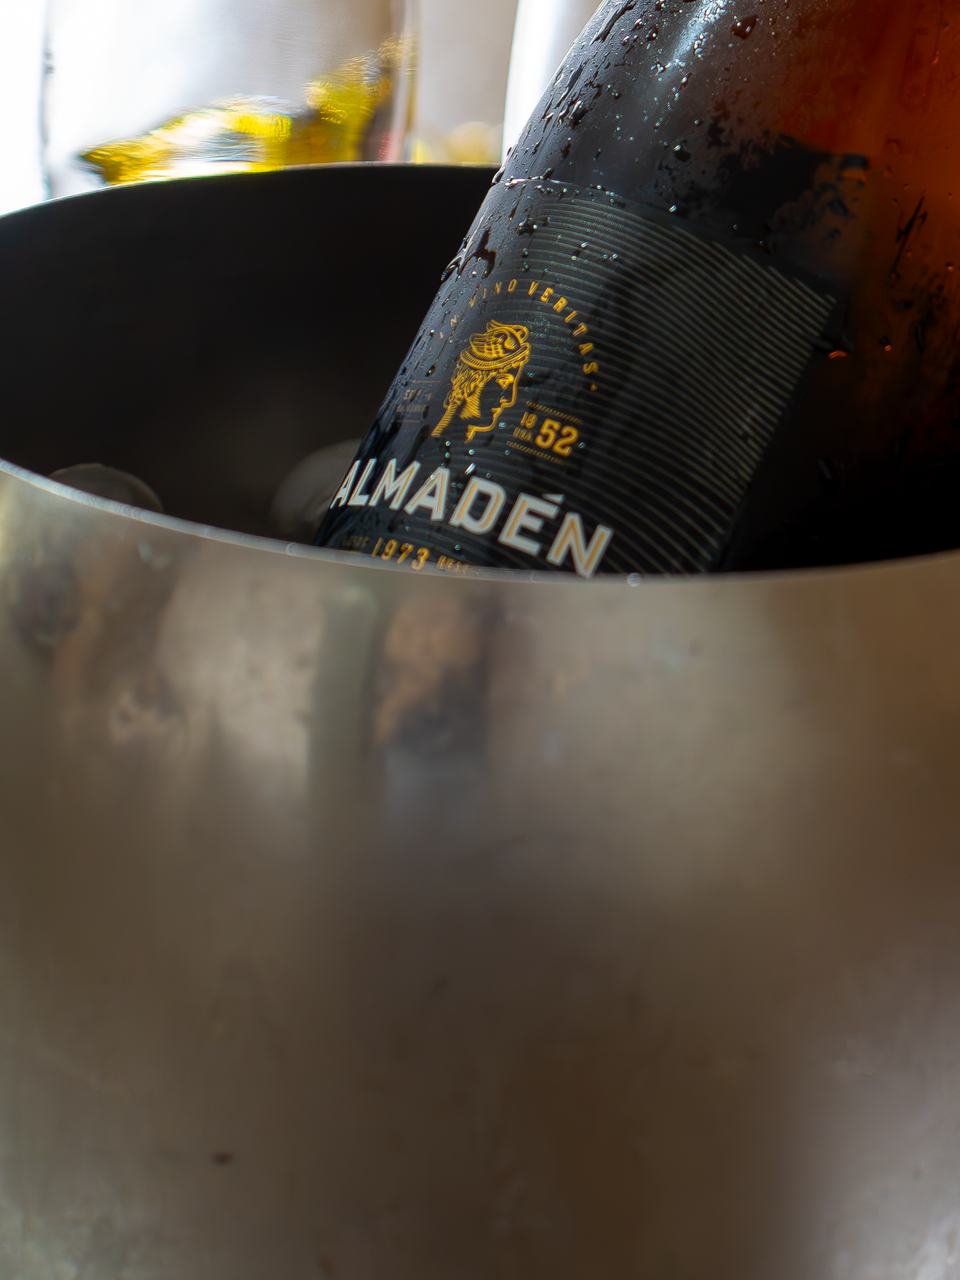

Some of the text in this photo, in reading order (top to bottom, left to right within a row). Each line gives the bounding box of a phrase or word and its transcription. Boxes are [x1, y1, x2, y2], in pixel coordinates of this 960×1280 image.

[534, 418, 579, 458] 52
[330, 458, 614, 579] ALMADÉN
[371, 537, 430, 571] 1973
